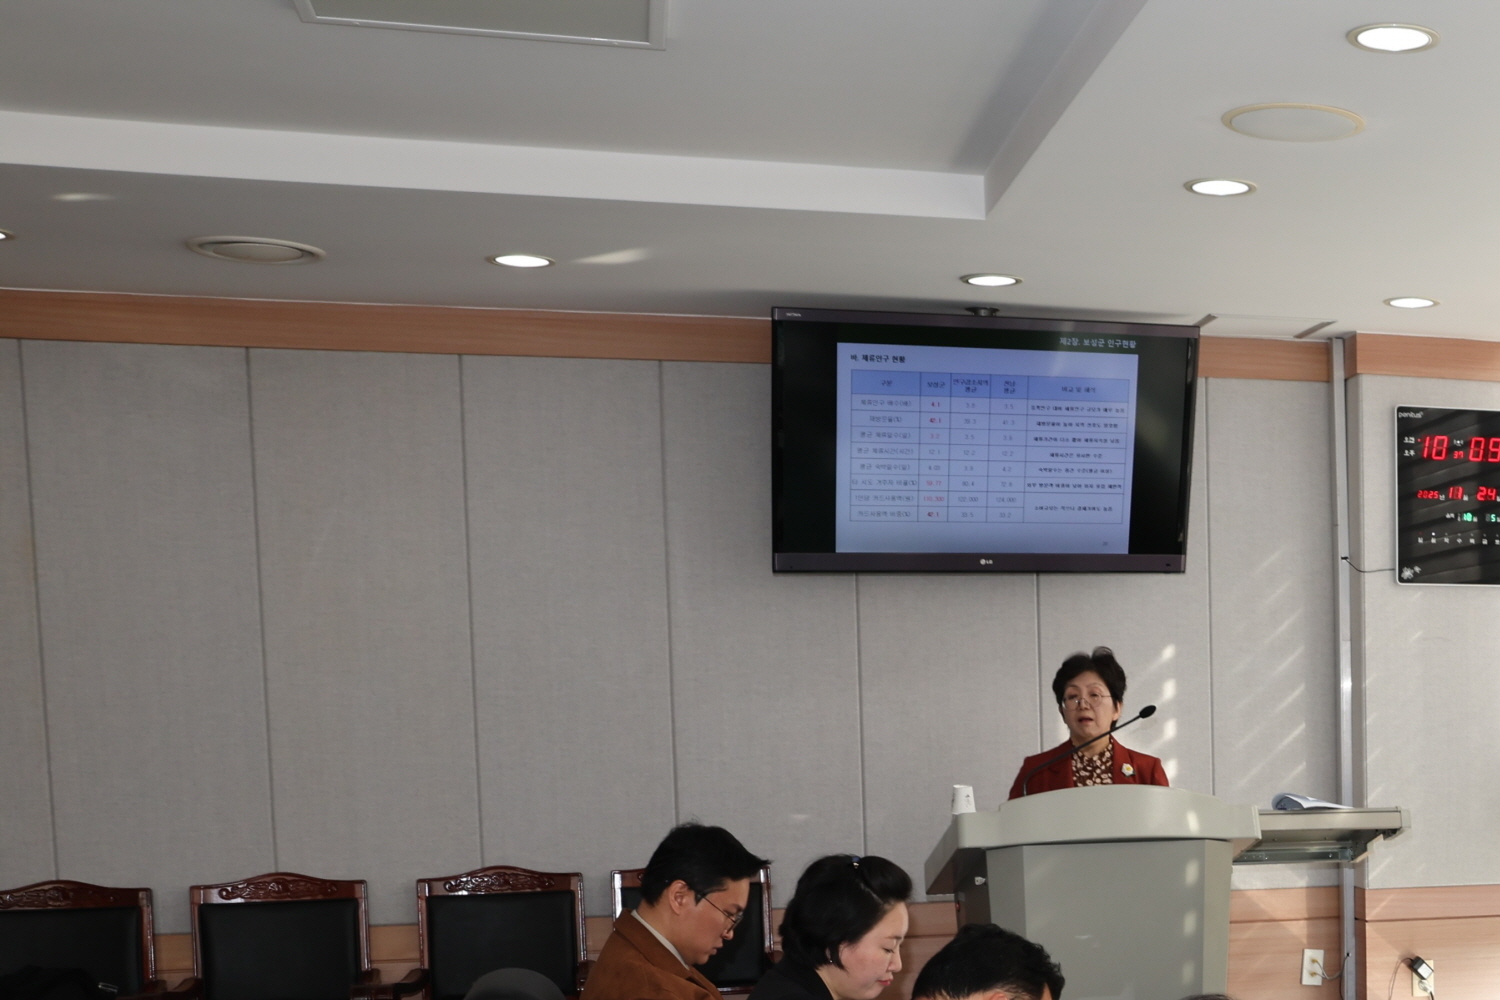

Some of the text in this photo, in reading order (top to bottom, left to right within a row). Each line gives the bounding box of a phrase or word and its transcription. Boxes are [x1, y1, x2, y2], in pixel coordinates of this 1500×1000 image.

[1059, 337, 1137, 349] 제2장. 보성군 인구현황
[1422, 435, 1449, 460] 10
